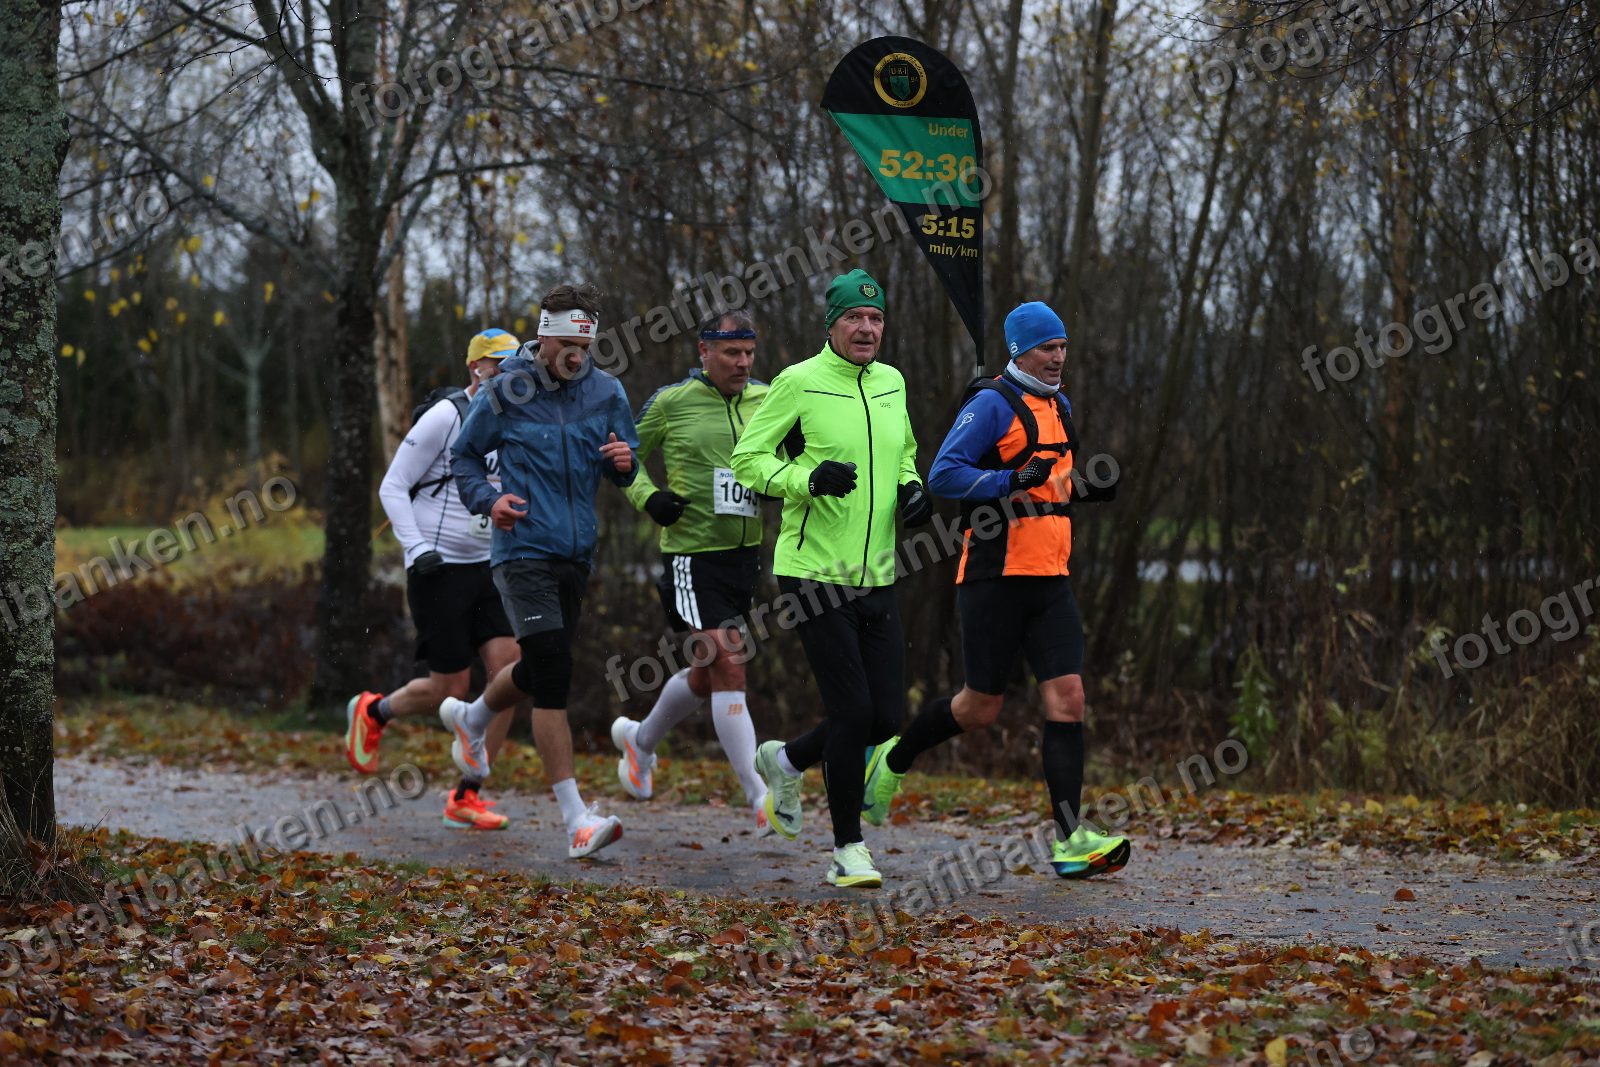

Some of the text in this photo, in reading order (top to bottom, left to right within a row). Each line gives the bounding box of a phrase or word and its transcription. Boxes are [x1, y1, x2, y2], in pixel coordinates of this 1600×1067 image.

[928, 123, 968, 138] Under
[879, 149, 978, 185] 52:30
[921, 213, 976, 239] 5:15
[929, 242, 978, 258] min/km
